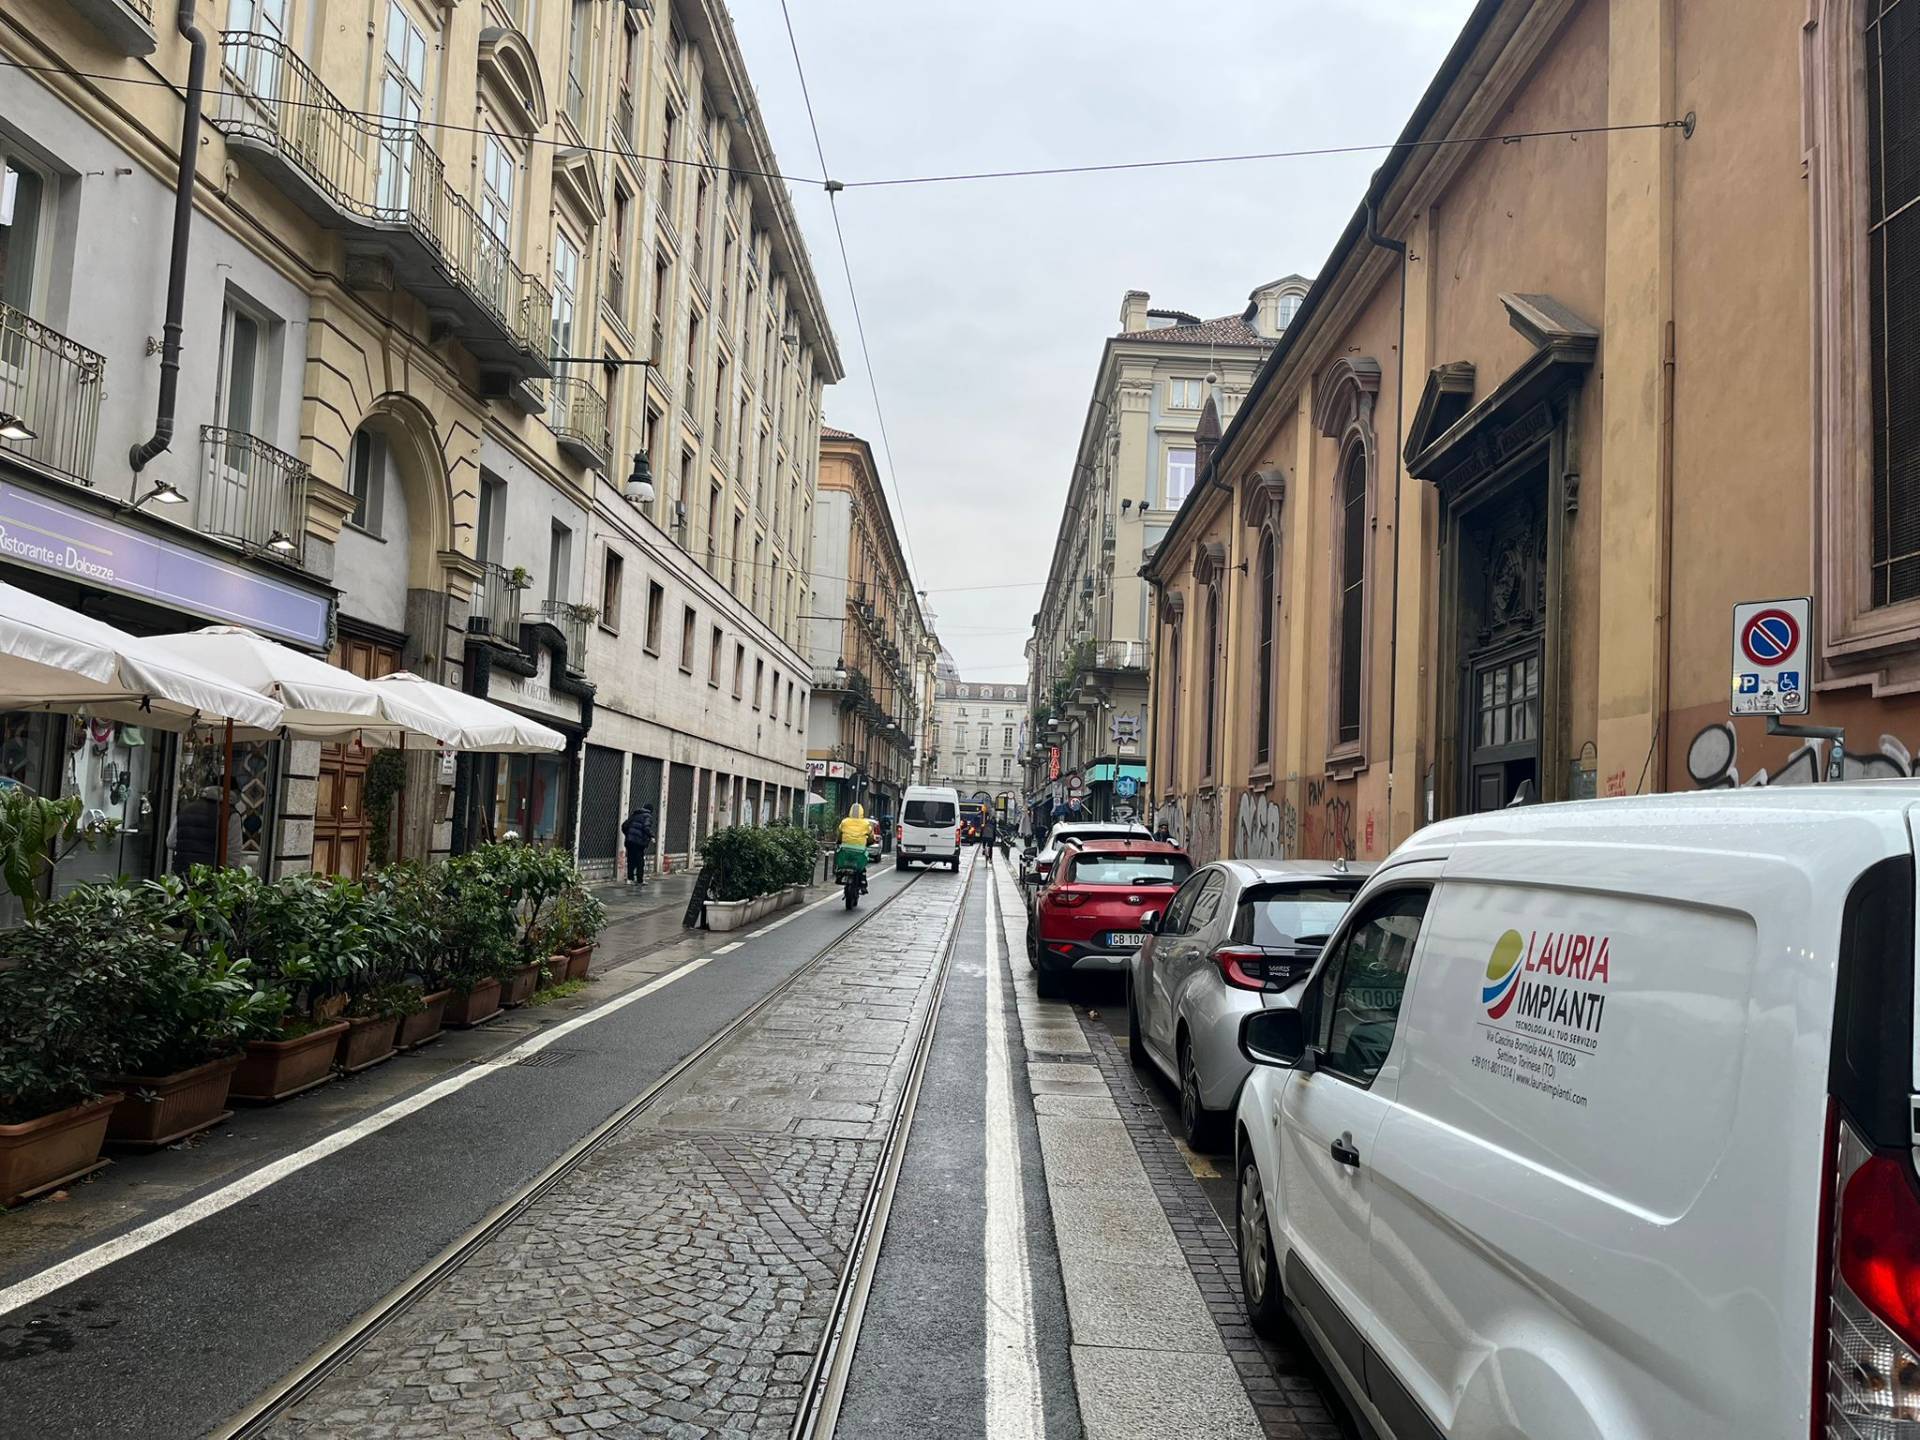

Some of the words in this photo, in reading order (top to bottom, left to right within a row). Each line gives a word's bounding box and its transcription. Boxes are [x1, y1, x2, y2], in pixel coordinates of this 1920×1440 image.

[56, 553, 63, 566] e
[65, 546, 114, 580] Dolcezze
[1743, 676, 1756, 691] P
[1050, 746, 1060, 780] BAR
[1113, 934, 1125, 945] GB
[1524, 930, 1609, 984] LAURIA
[1517, 981, 1606, 1033] IMPIANTI
[1515, 1020, 1547, 1036] TECNOLOGIA
[1547, 1029, 1556, 1039] AL
[1556, 1030, 1569, 1042] TUO
[1569, 1033, 1598, 1049] SERVIZIO
[1556, 1049, 1577, 1067] 10036
[1515, 1073, 1588, 1108] www.lauriaimpianti.com
